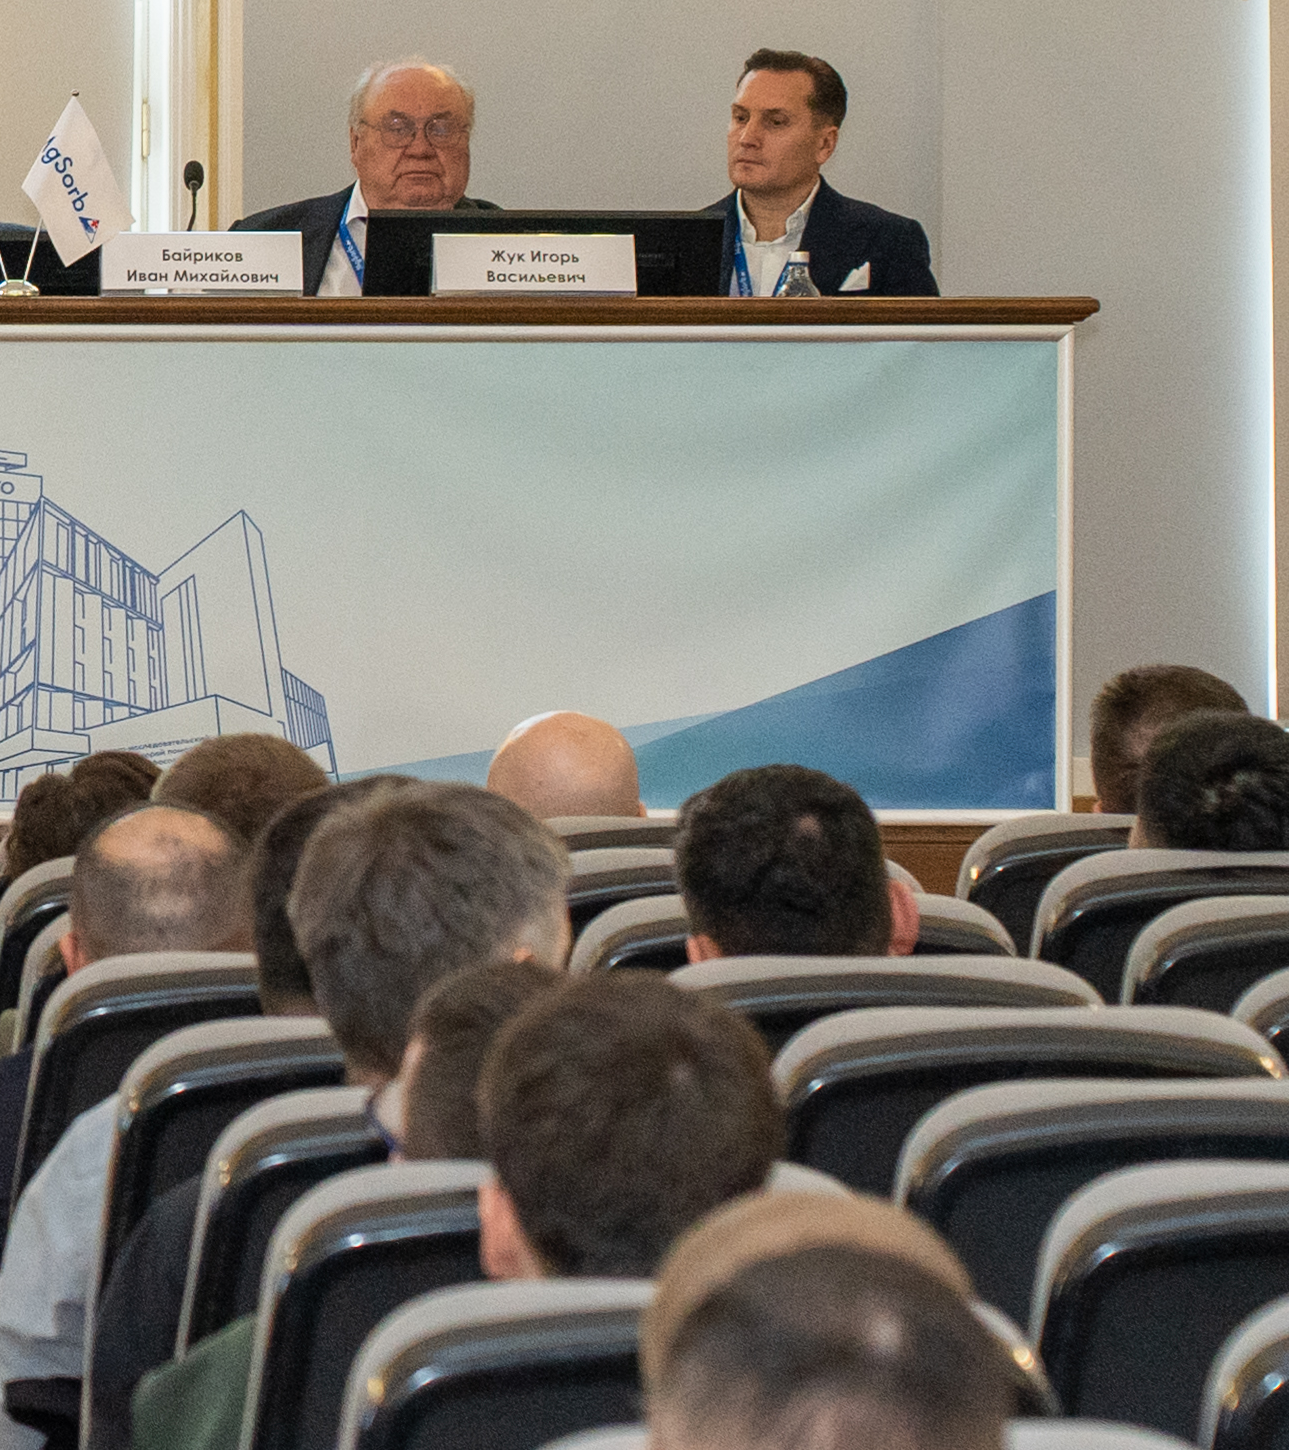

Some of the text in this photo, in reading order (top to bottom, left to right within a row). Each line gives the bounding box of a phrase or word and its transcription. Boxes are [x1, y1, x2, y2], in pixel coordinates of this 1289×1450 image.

[162, 248, 244, 265] Байриков
[491, 249, 580, 266] Жук Игорь
[126, 269, 279, 283] Иван Михайлович
[486, 269, 586, 284] Васильевич
